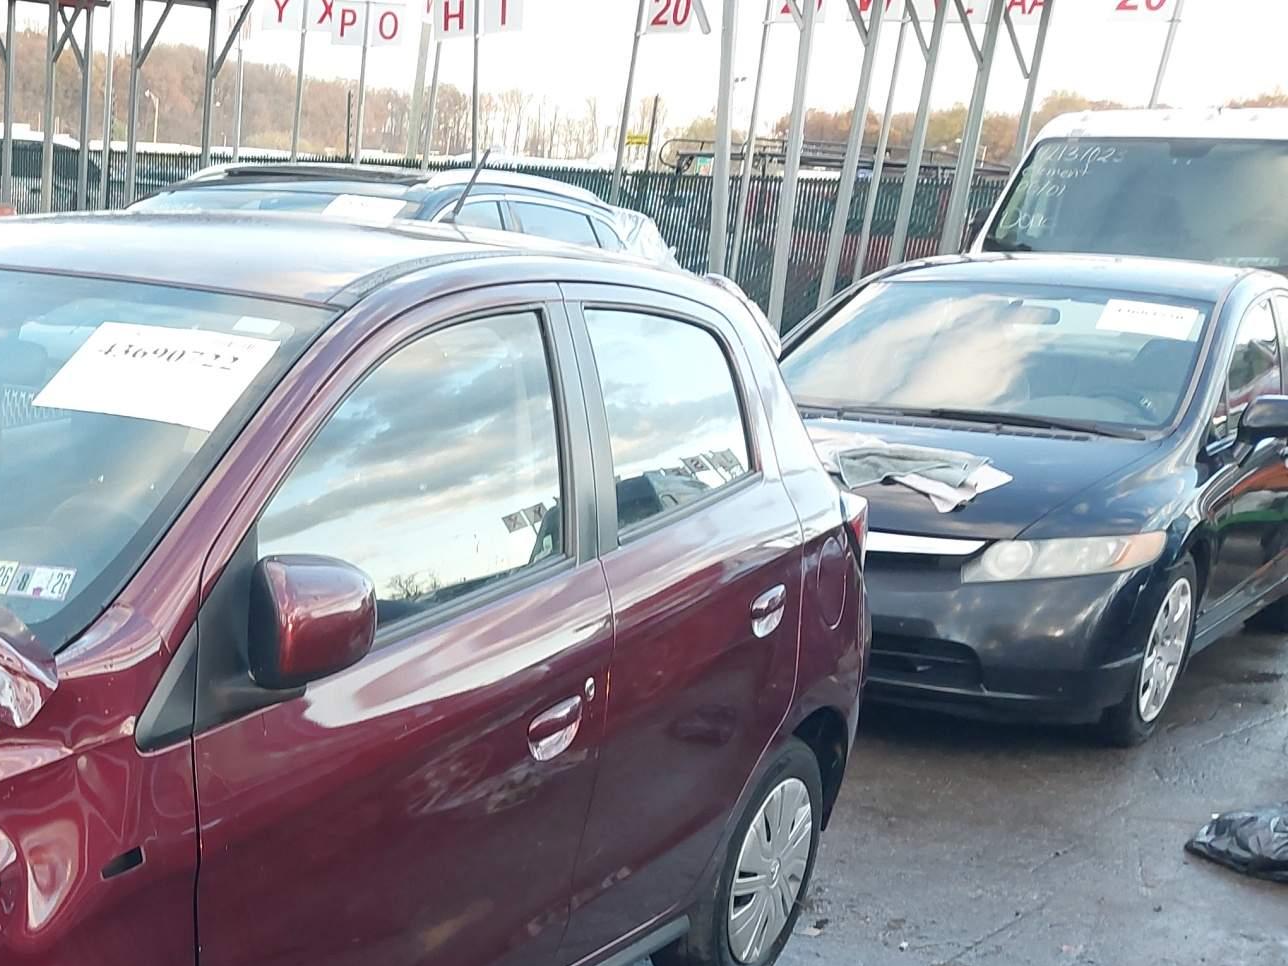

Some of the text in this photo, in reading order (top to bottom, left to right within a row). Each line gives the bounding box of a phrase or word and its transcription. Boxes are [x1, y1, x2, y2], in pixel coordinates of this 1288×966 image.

[339, 9, 399, 40] P O
[443, 0, 464, 31] H
[650, 0, 692, 27] 20
